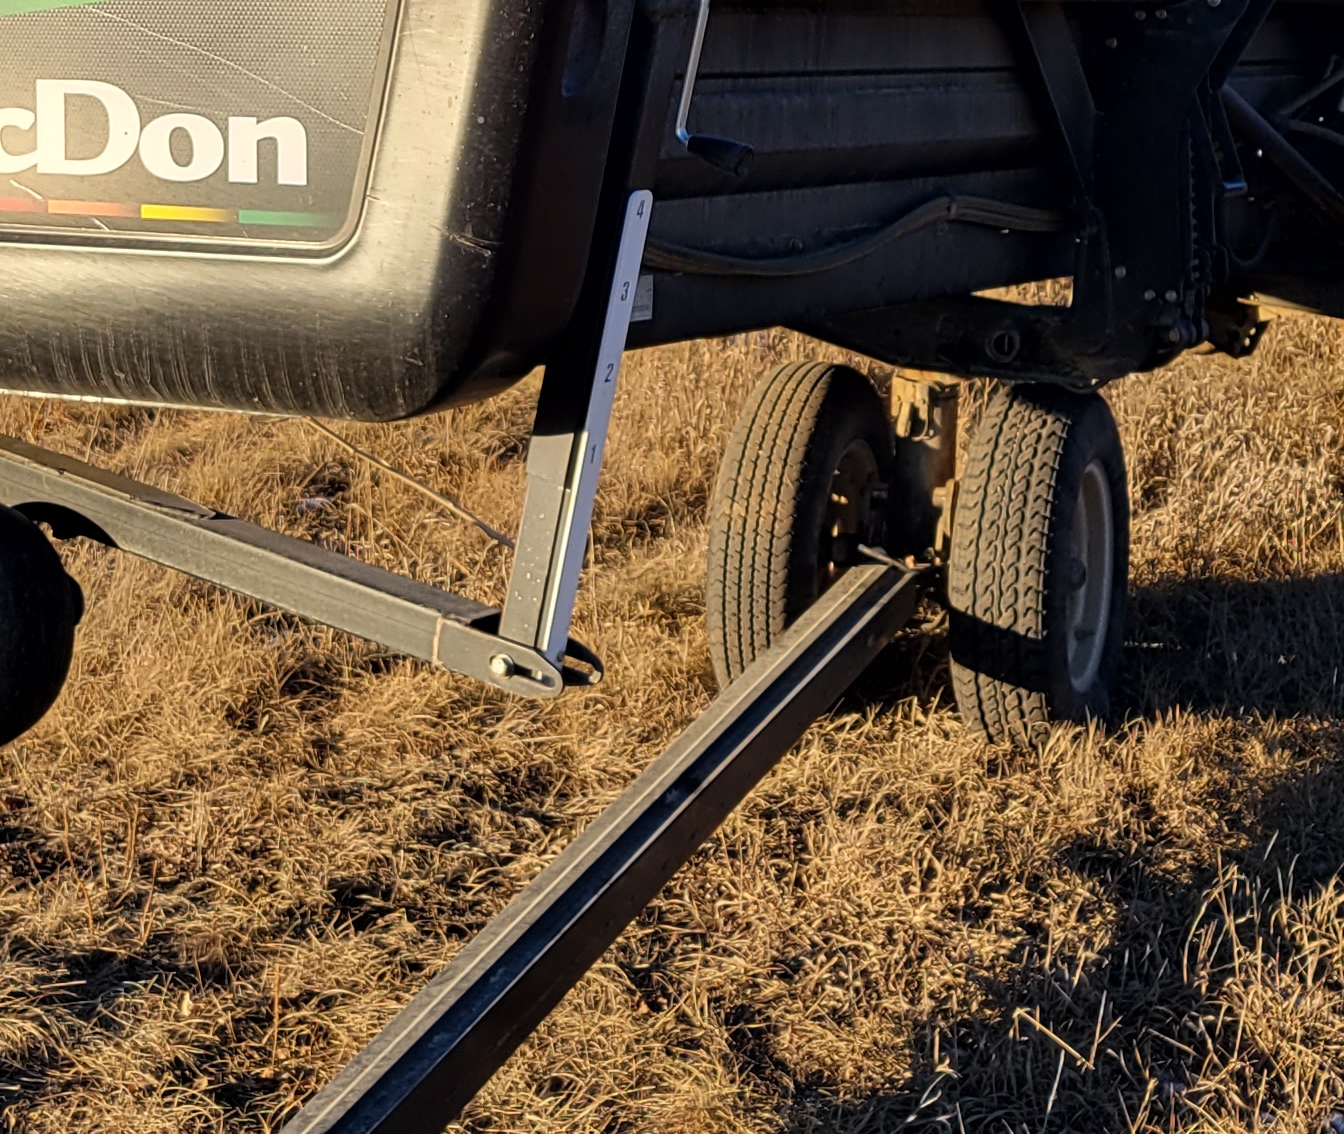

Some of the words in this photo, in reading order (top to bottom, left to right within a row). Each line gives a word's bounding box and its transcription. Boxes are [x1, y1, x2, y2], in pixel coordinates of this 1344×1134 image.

[636, 200, 646, 219] 4
[620, 281, 630, 301] 3
[604, 363, 614, 383] 2
[590, 445, 597, 464] 1
